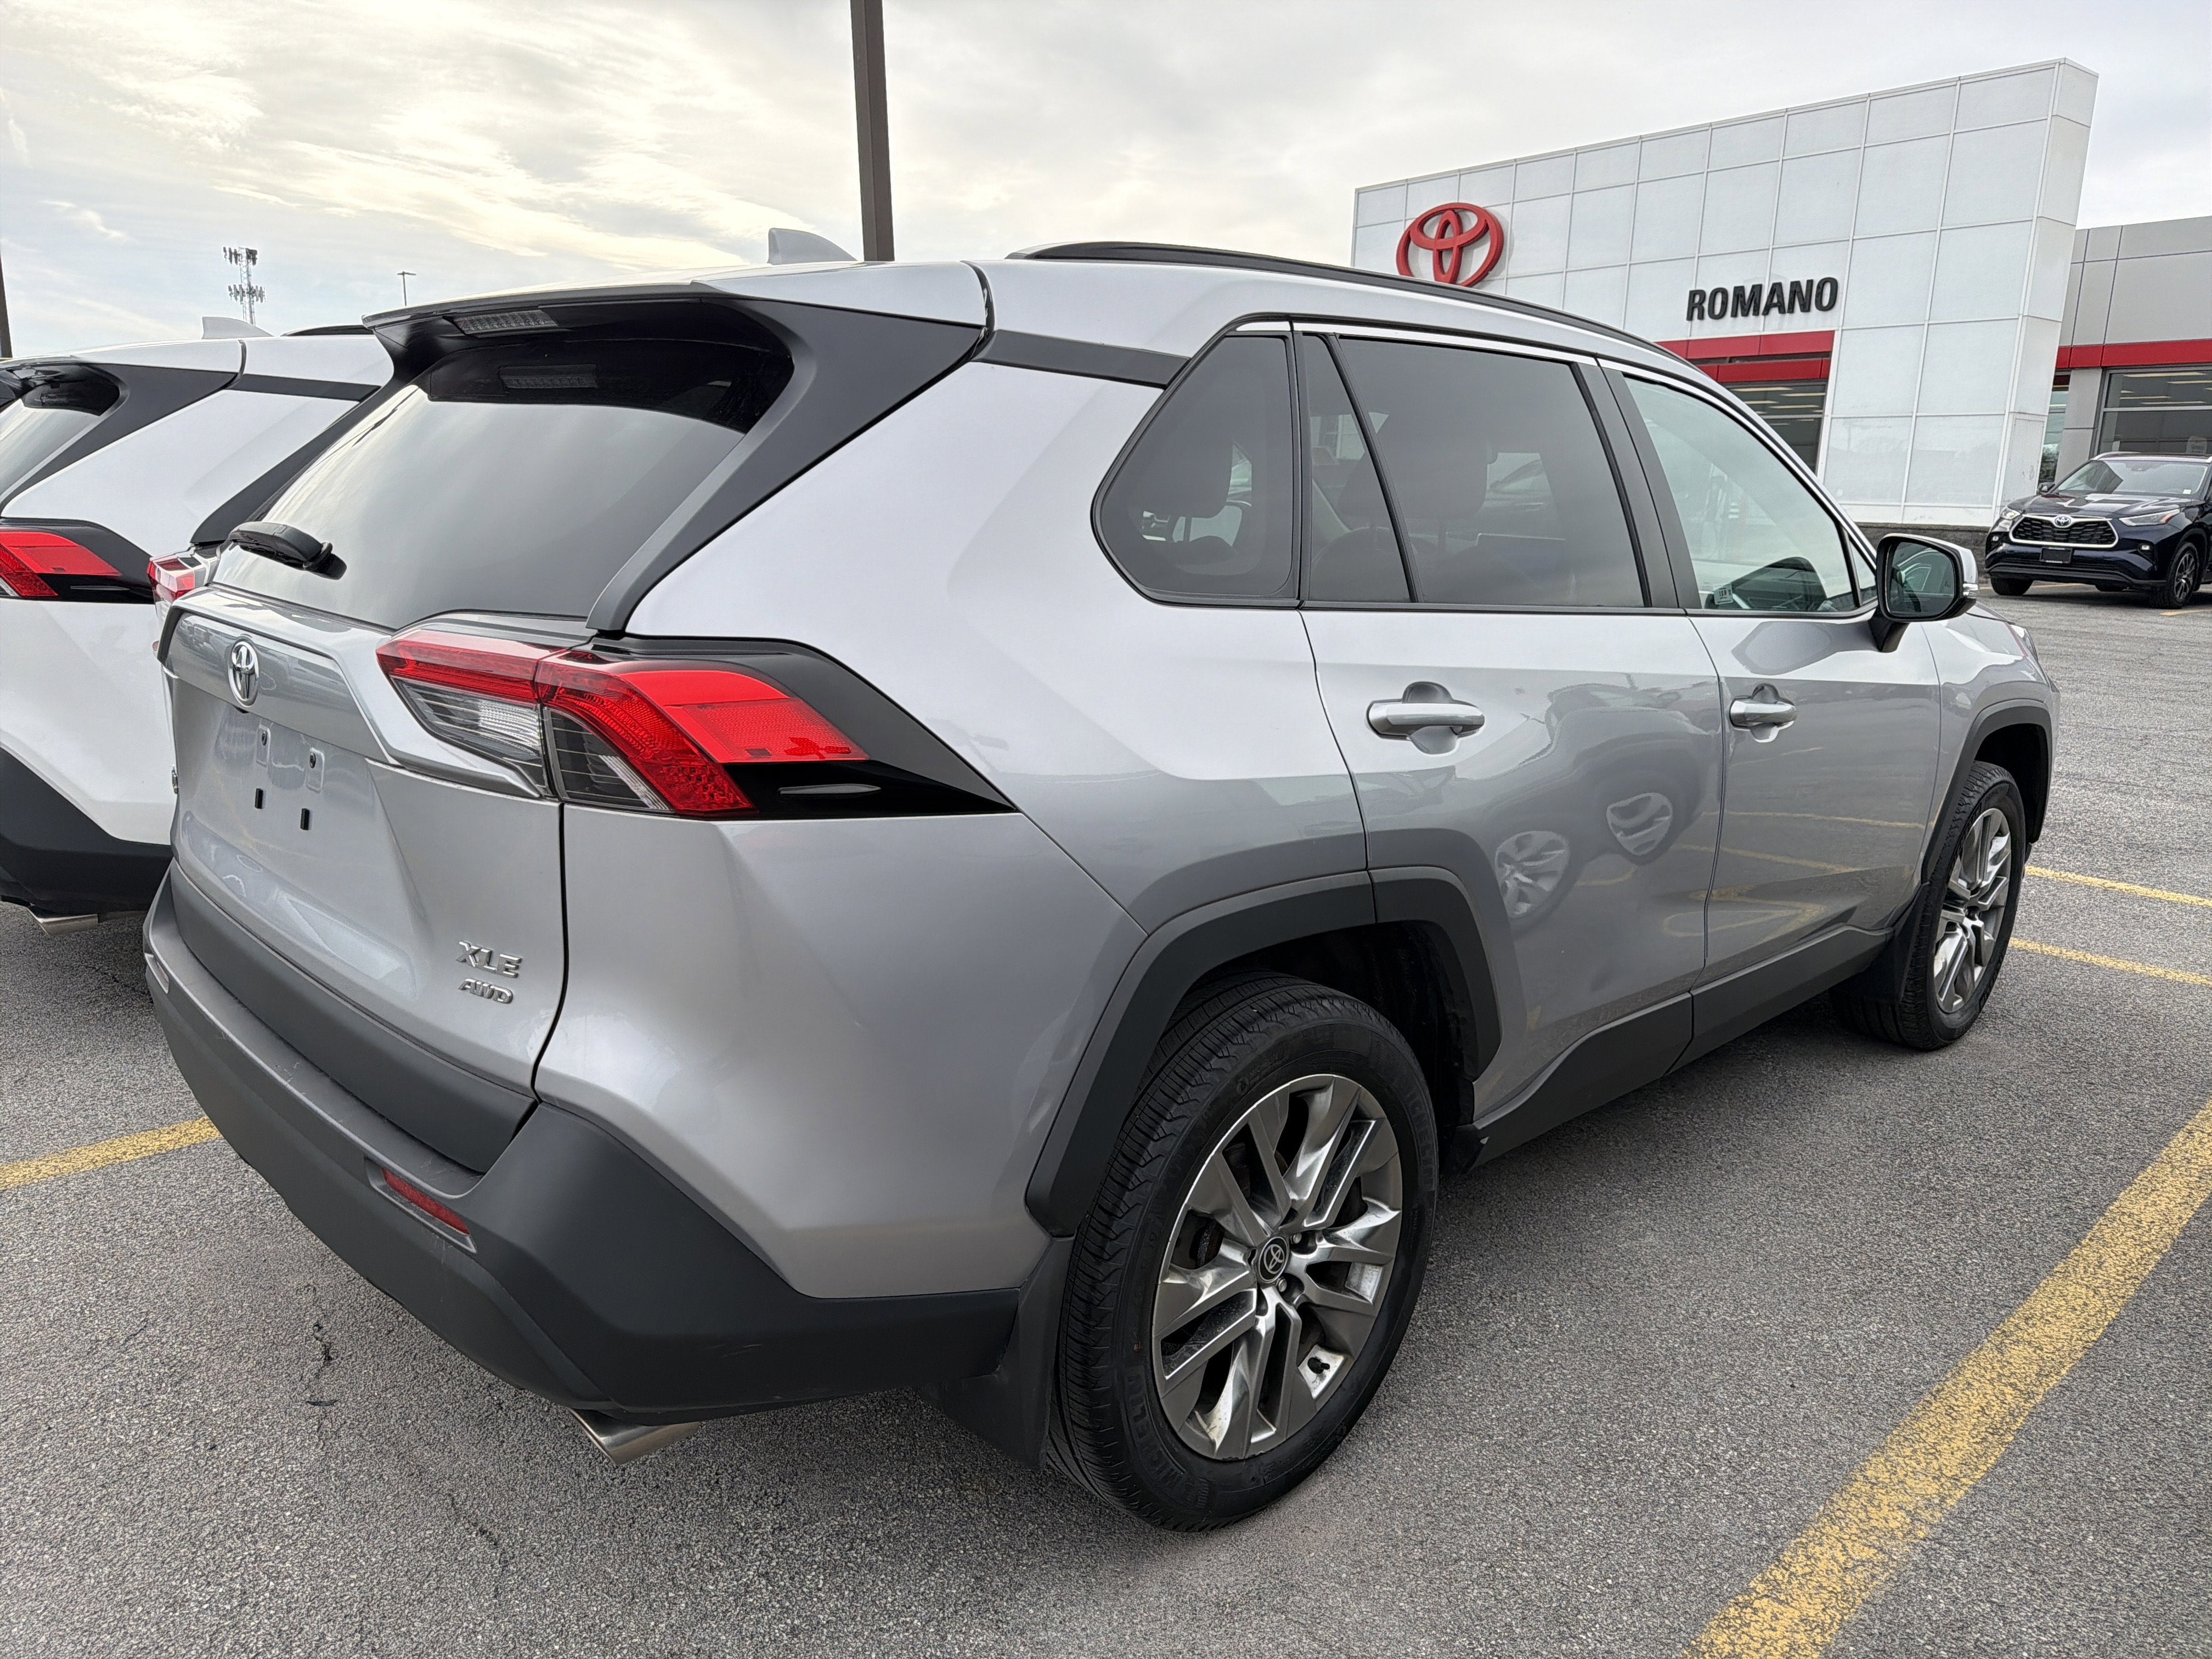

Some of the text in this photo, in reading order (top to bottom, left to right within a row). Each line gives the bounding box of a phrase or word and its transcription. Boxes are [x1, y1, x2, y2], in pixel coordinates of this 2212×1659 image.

[1686, 276, 1838, 321] ROMANO
[456, 941, 522, 978] XLE
[458, 978, 513, 1004] AWD
